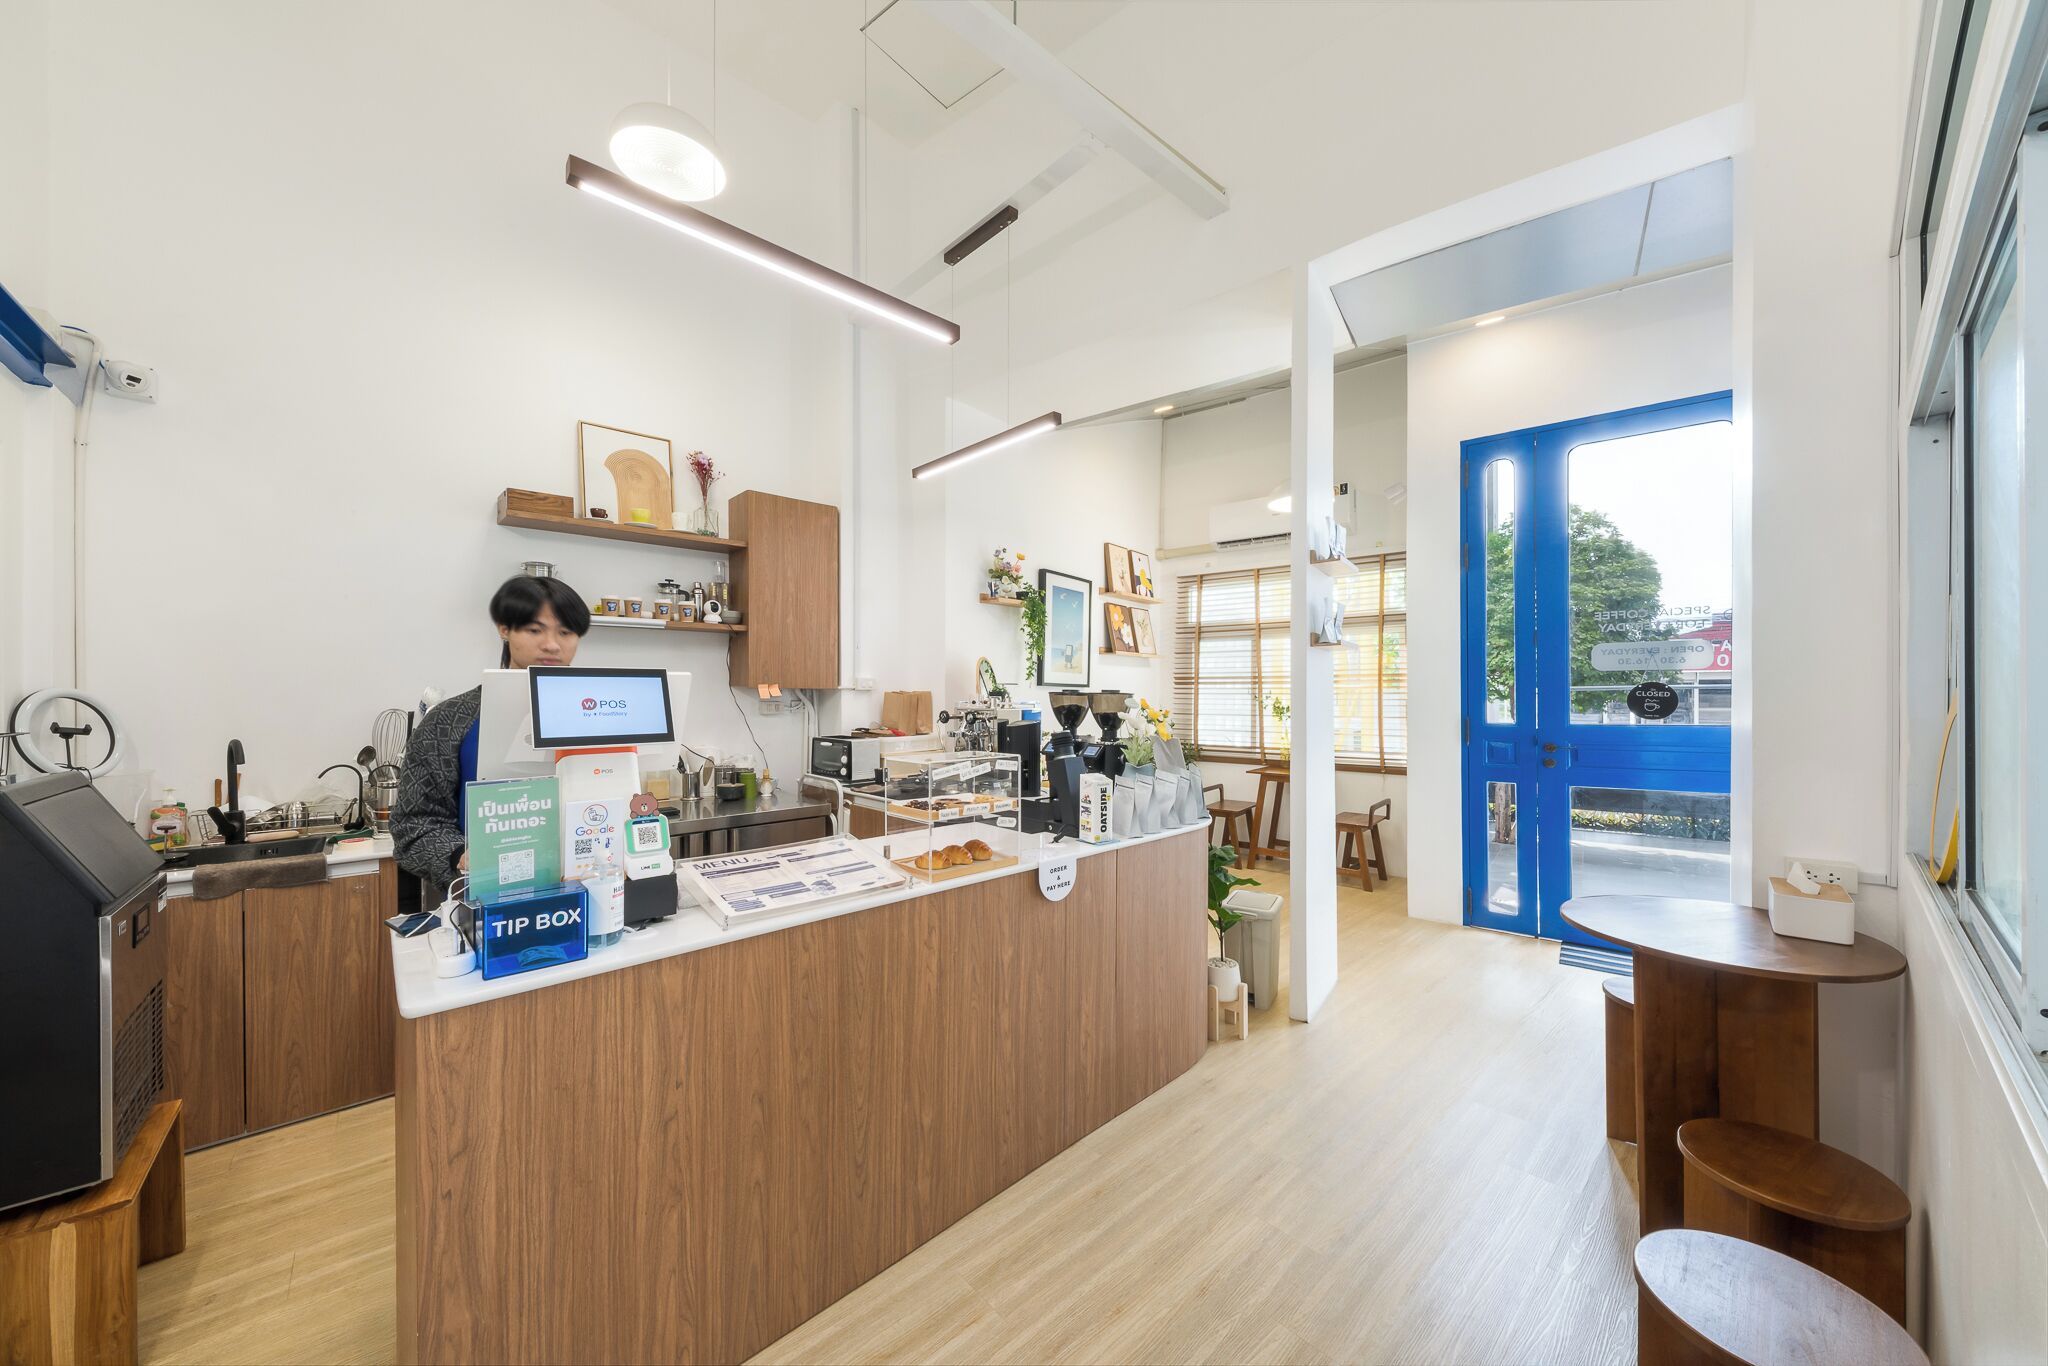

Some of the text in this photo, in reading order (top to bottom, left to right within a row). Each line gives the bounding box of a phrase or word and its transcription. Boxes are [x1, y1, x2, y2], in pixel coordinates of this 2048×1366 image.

[1636, 690, 1670, 698] CLOSED
[599, 700, 627, 709] POS
[478, 793, 552, 818] เป็นเพื่อน
[1100, 787, 1108, 833] OATSIDE
[485, 815, 546, 834] กันเถอะ
[692, 857, 750, 871] MENU
[1050, 865, 1067, 874] ORDER
[1046, 880, 1071, 892] PAY HERE
[492, 908, 581, 937] TIP BOX
